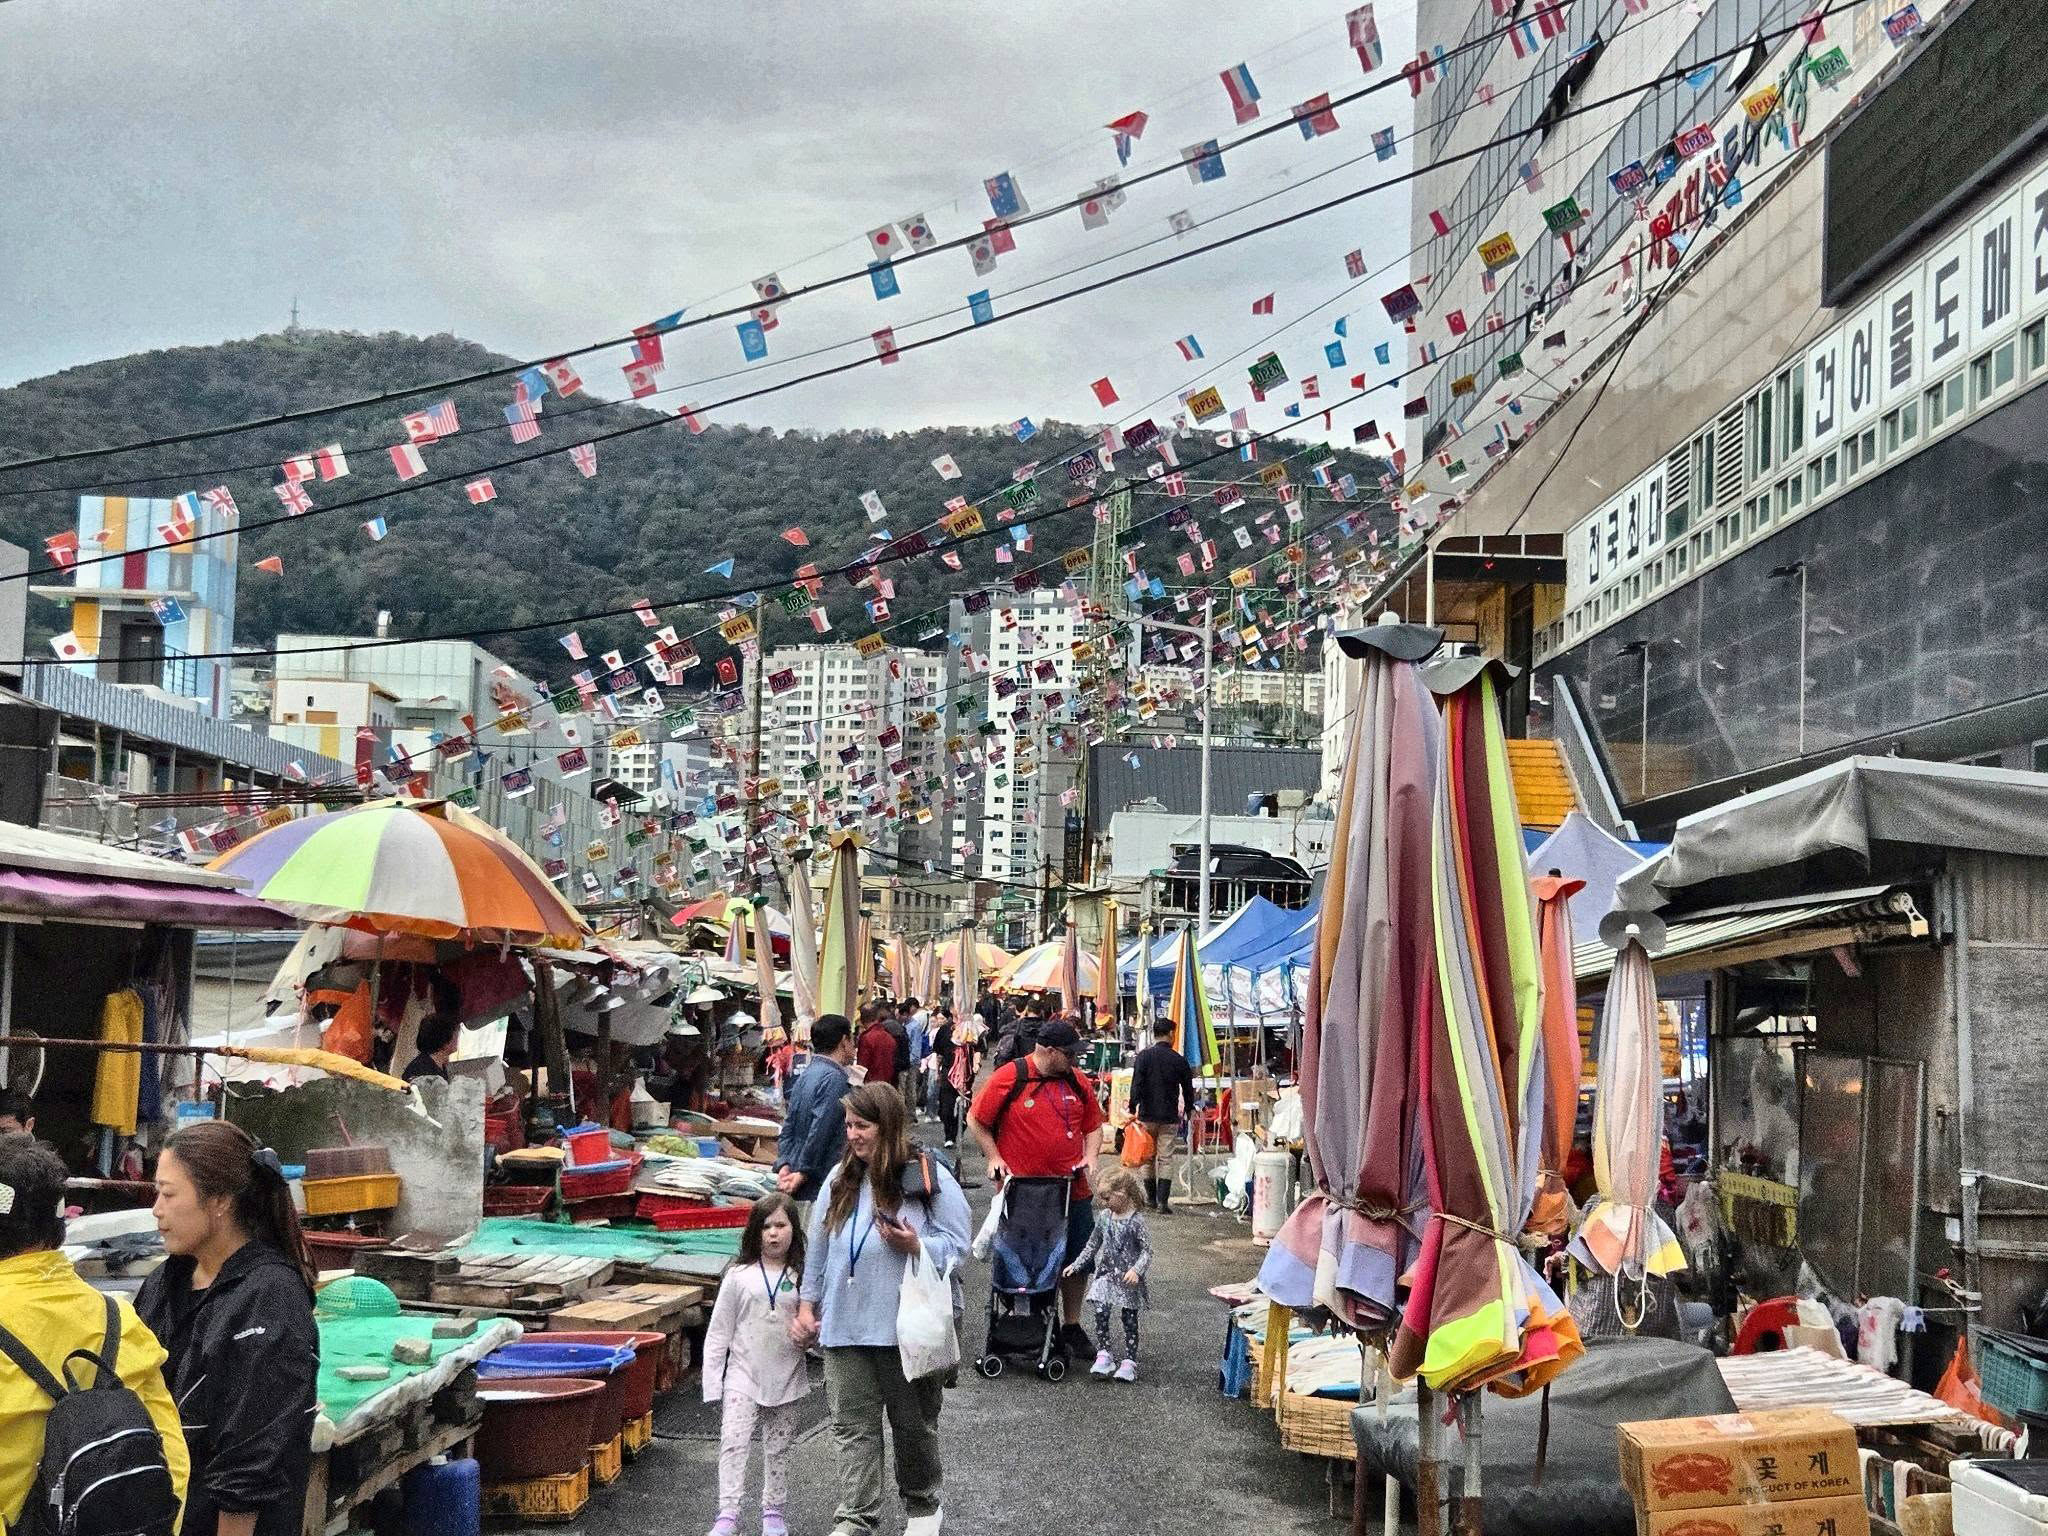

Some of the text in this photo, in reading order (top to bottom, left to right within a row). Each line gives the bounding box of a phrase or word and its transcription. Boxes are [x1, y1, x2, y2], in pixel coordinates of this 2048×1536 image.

[1889, 12, 1918, 36] OPEN
[1816, 55, 1843, 79] OPEN
[1750, 93, 1777, 116] OPEN
[1684, 133, 1710, 152] OPEN
[1615, 170, 1644, 191] OPEN
[1547, 206, 1578, 228] OPEN
[1485, 243, 1512, 263] OPEN
[1255, 364, 1281, 383] OPEN
[1194, 395, 1219, 414] OPEN
[1069, 457, 1095, 478] OPEN
[1263, 467, 1283, 483] OPEN
[1012, 487, 1035, 506] OPEN
[1218, 490, 1240, 504] OPEN
[954, 516, 979, 532] OPEN
[1588, 474, 1663, 585] 전국최대
[1067, 554, 1088, 567] OPEN
[786, 594, 810, 612] OPEN
[726, 621, 750, 637] OPEN
[917, 616, 936, 631] OPEN
[667, 647, 693, 662] OPEN
[861, 641, 881, 654] OPEN
[613, 673, 636, 689] OPEN
[773, 677, 794, 689] OPEN
[558, 696, 580, 710] OPEN
[501, 718, 525, 731] OPEN
[671, 715, 693, 728] OPEN
[616, 733, 638, 747] OPEN
[562, 755, 584, 769] OPEN
[506, 775, 528, 788] OPEN
[763, 782, 780, 794] OPEN
[216, 834, 239, 850] OPEN
[589, 848, 606, 858] OPEN
[1757, 1451, 1830, 1481] 꽃 게
[1794, 1481, 1808, 1491] OF
[1811, 1477, 1850, 1488] KOREA
